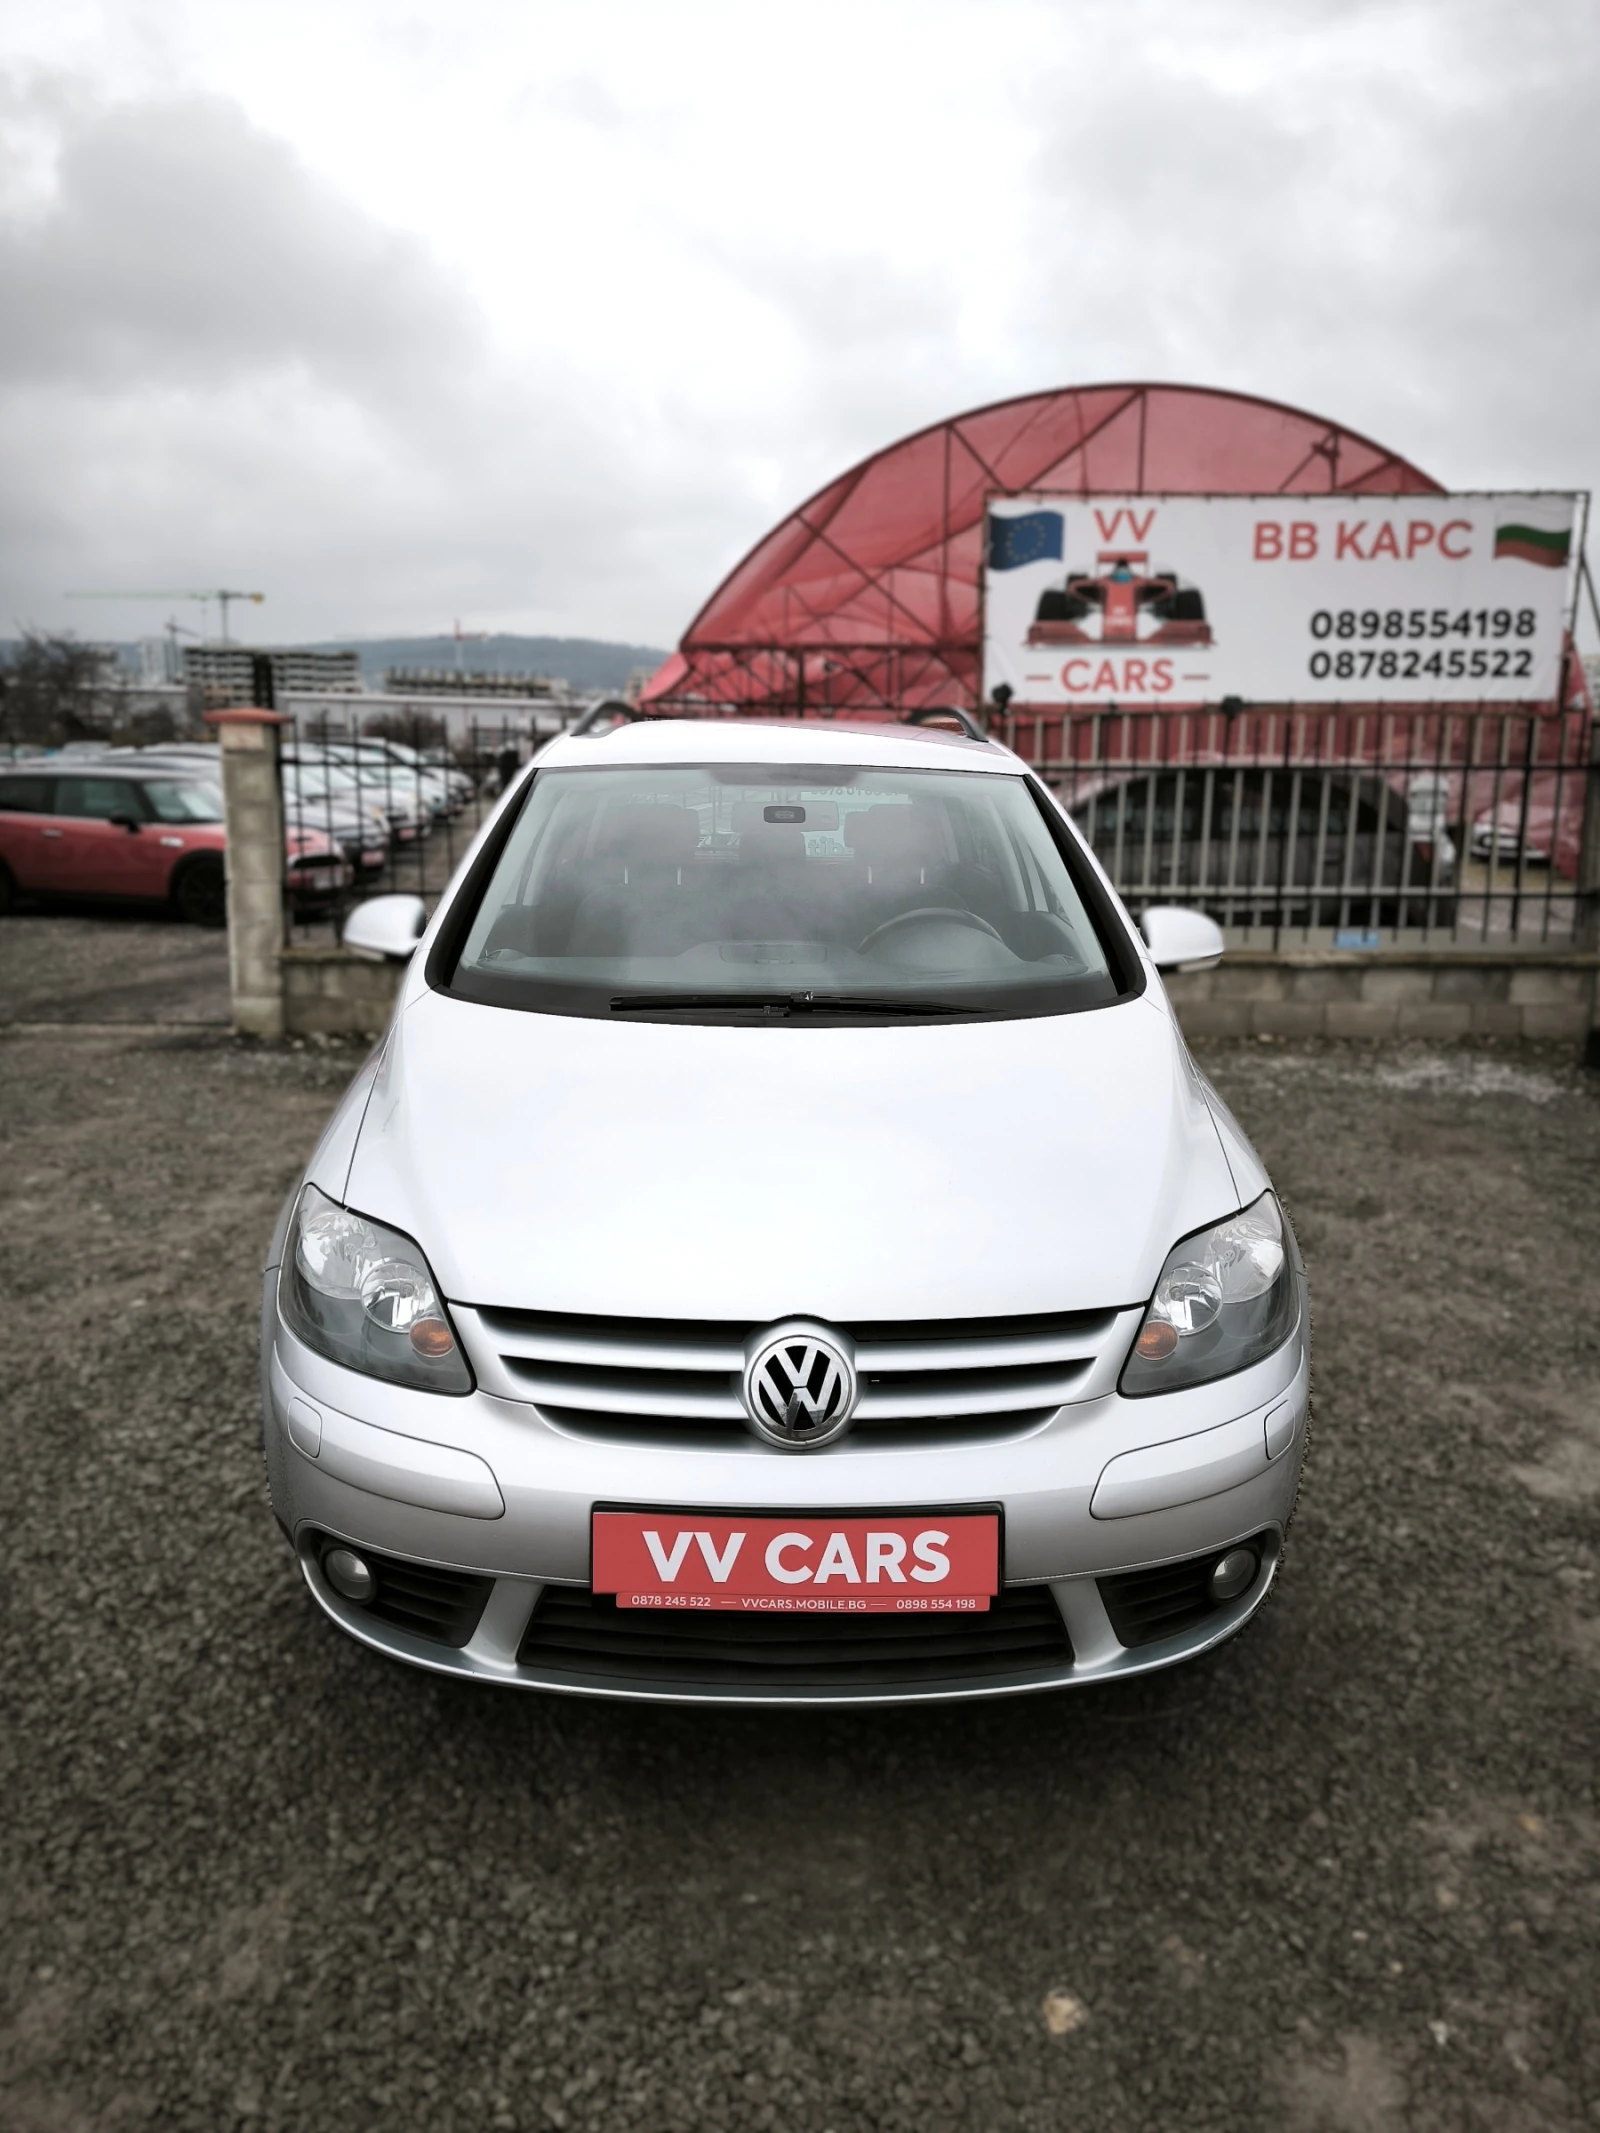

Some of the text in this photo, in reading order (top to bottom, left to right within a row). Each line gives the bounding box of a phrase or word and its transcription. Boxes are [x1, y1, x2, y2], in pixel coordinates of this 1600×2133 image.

[1094, 509, 1155, 542] VV
[1252, 521, 1473, 561] ВВ КАРС
[1310, 609, 1537, 639] 0898554198
[1060, 659, 1174, 693] CARS
[1309, 649, 1532, 679] 0878245522
[642, 1530, 951, 1585] VV CARS
[631, 1594, 977, 1611] 0878 245 522 VVCARS.MOBILE.BG 0898 554 198
